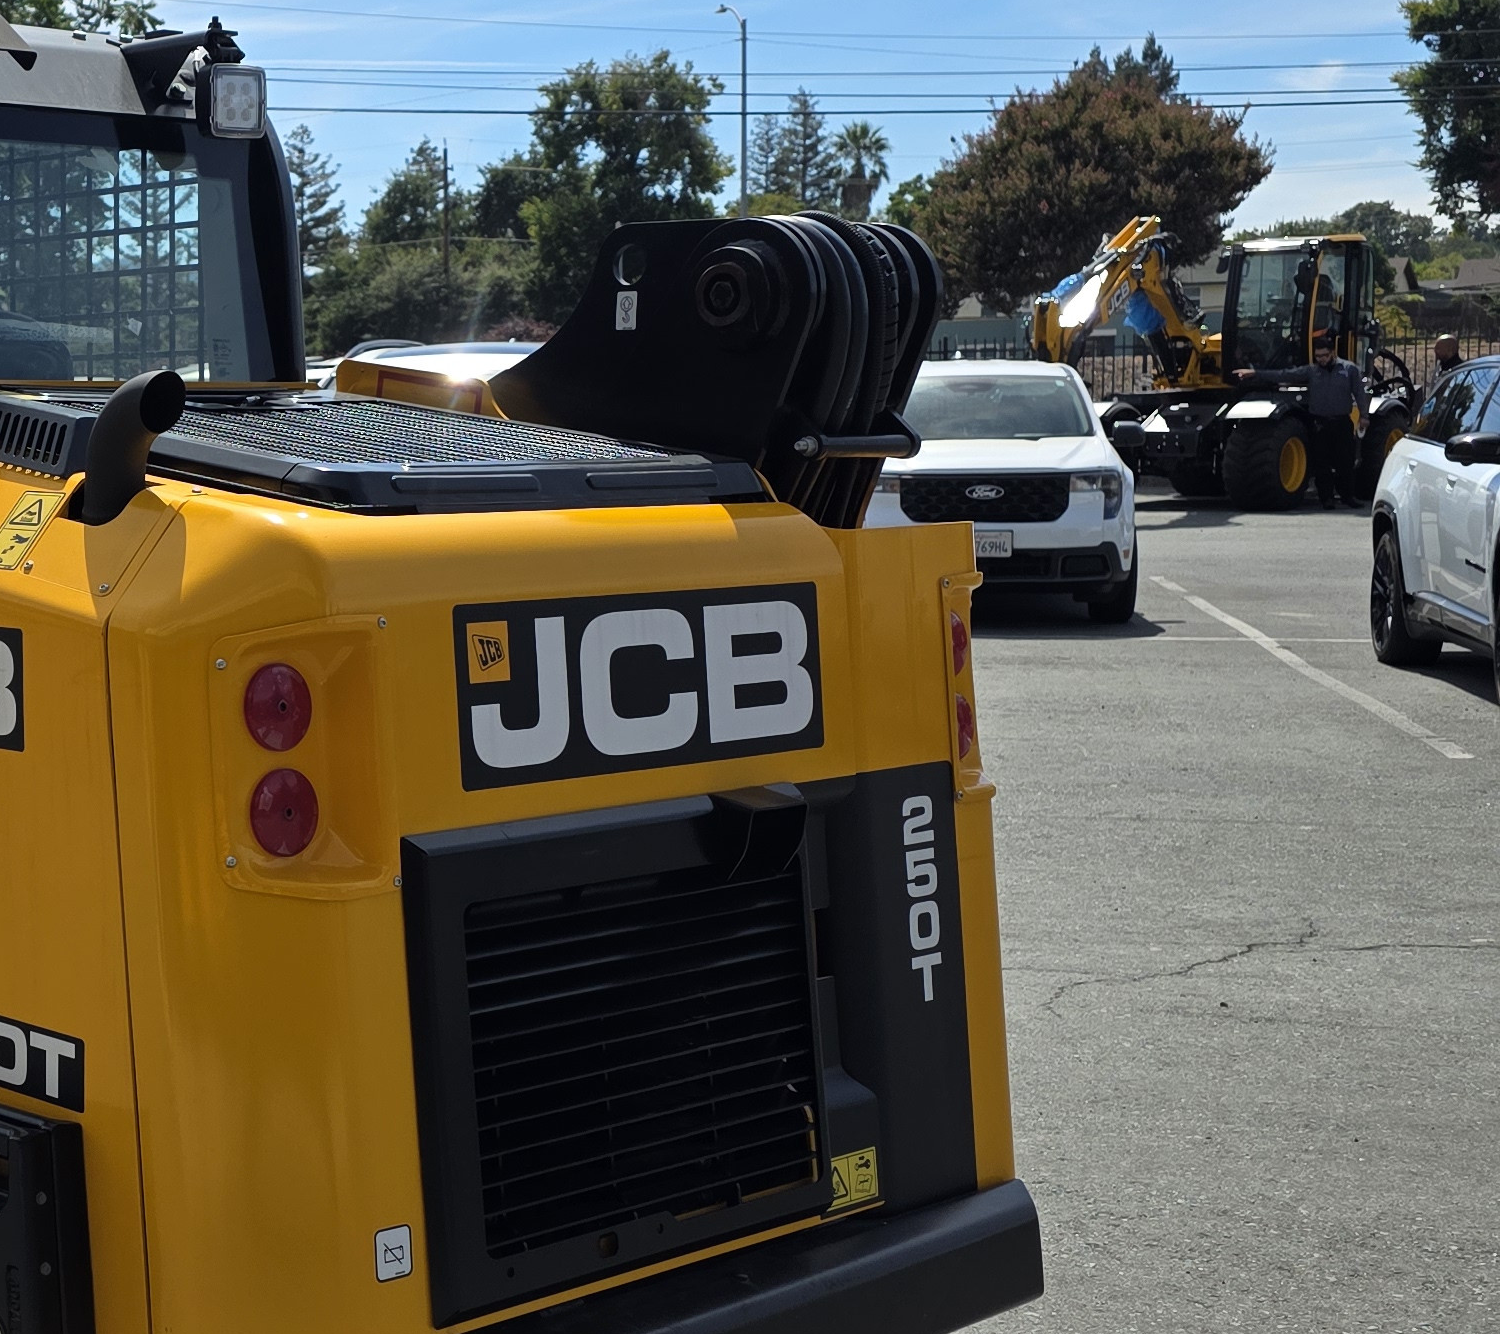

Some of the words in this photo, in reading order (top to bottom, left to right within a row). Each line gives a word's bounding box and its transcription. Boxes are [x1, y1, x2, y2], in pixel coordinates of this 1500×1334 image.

[1108, 279, 1130, 316] JCB
[969, 486, 1001, 499] Ford
[478, 638, 503, 667] JCB
[471, 600, 814, 768] JCB
[902, 795, 942, 1002] 250T
